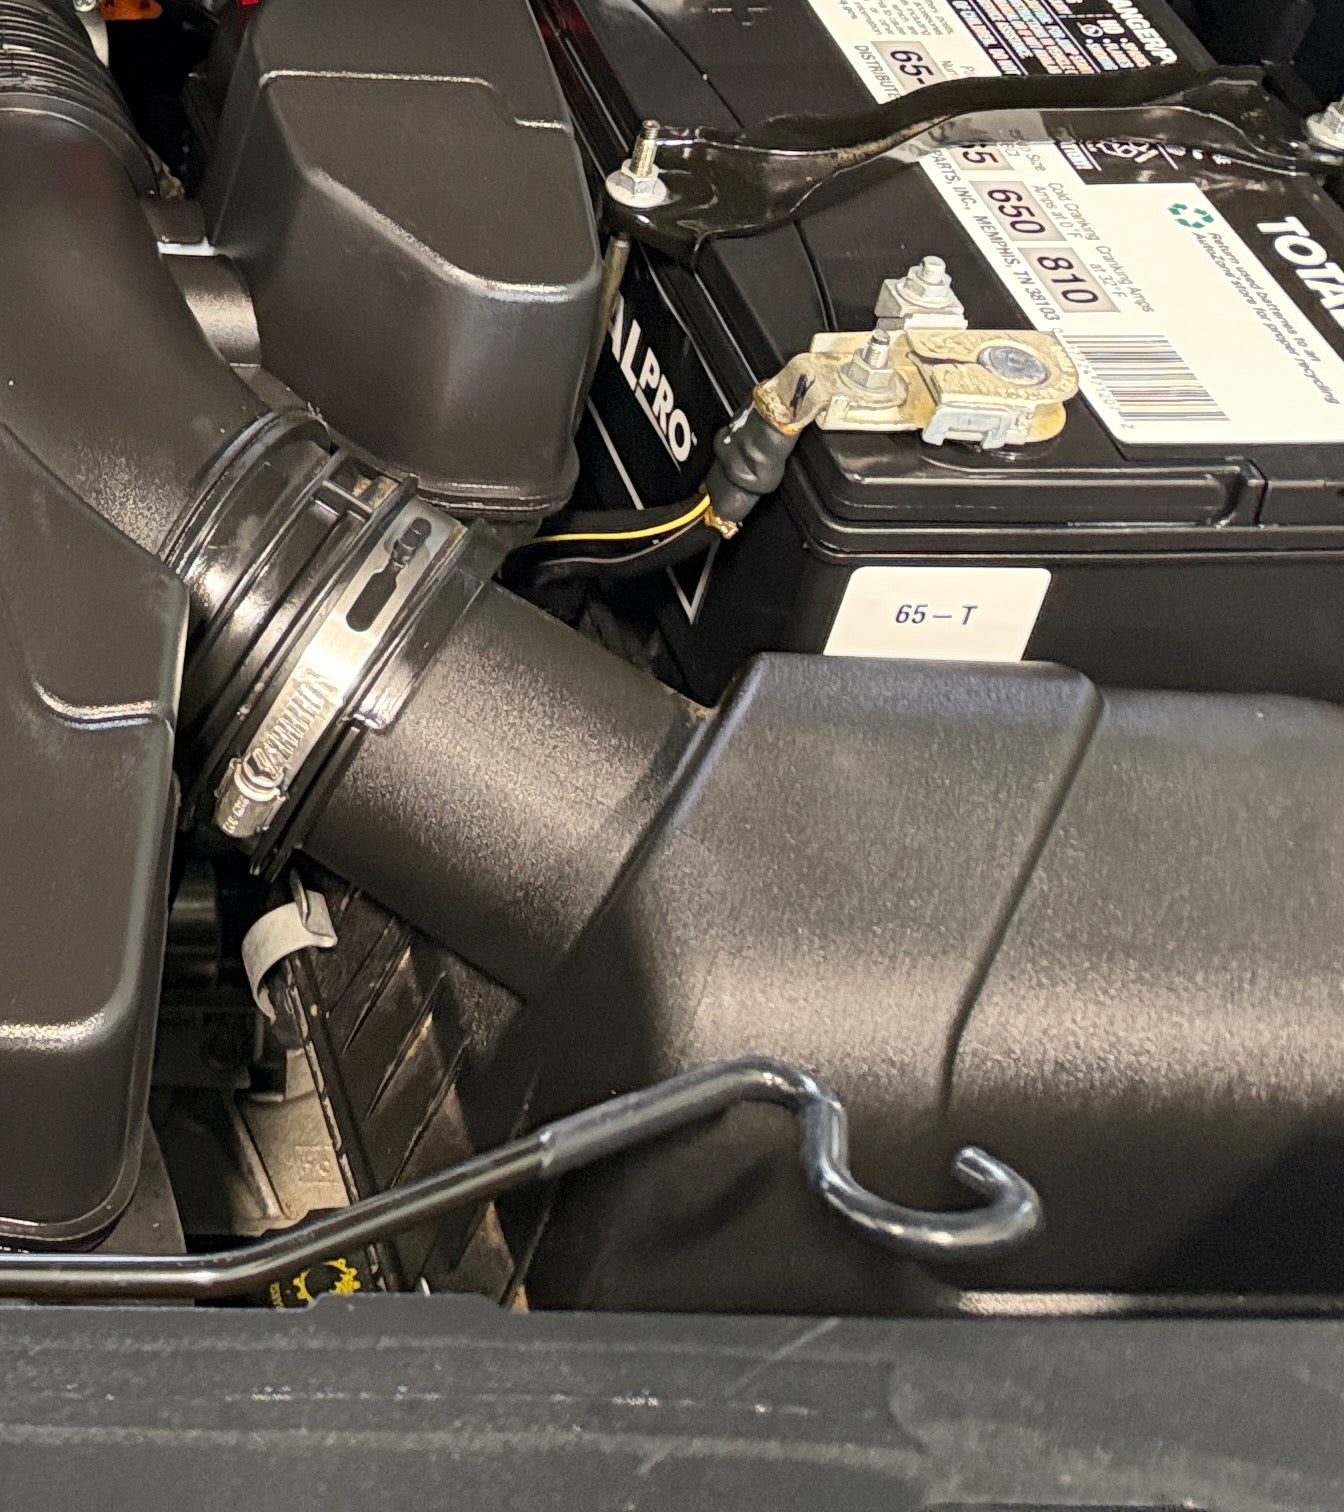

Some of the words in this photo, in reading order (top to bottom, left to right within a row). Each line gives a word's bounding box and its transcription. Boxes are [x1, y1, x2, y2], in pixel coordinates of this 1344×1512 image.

[854, 45, 901, 99] DISTRIBUTE
[891, 50, 934, 85] 65-
[987, 188, 1047, 236] 650
[1033, 184, 1058, 209] Amps
[1047, 182, 1072, 205] Cold
[1067, 201, 1101, 241] Cranking
[1036, 255, 1100, 305] 810
[1095, 244, 1134, 286] Cranking
[1126, 286, 1156, 314] Amps
[1024, 287, 1062, 322] 38103
